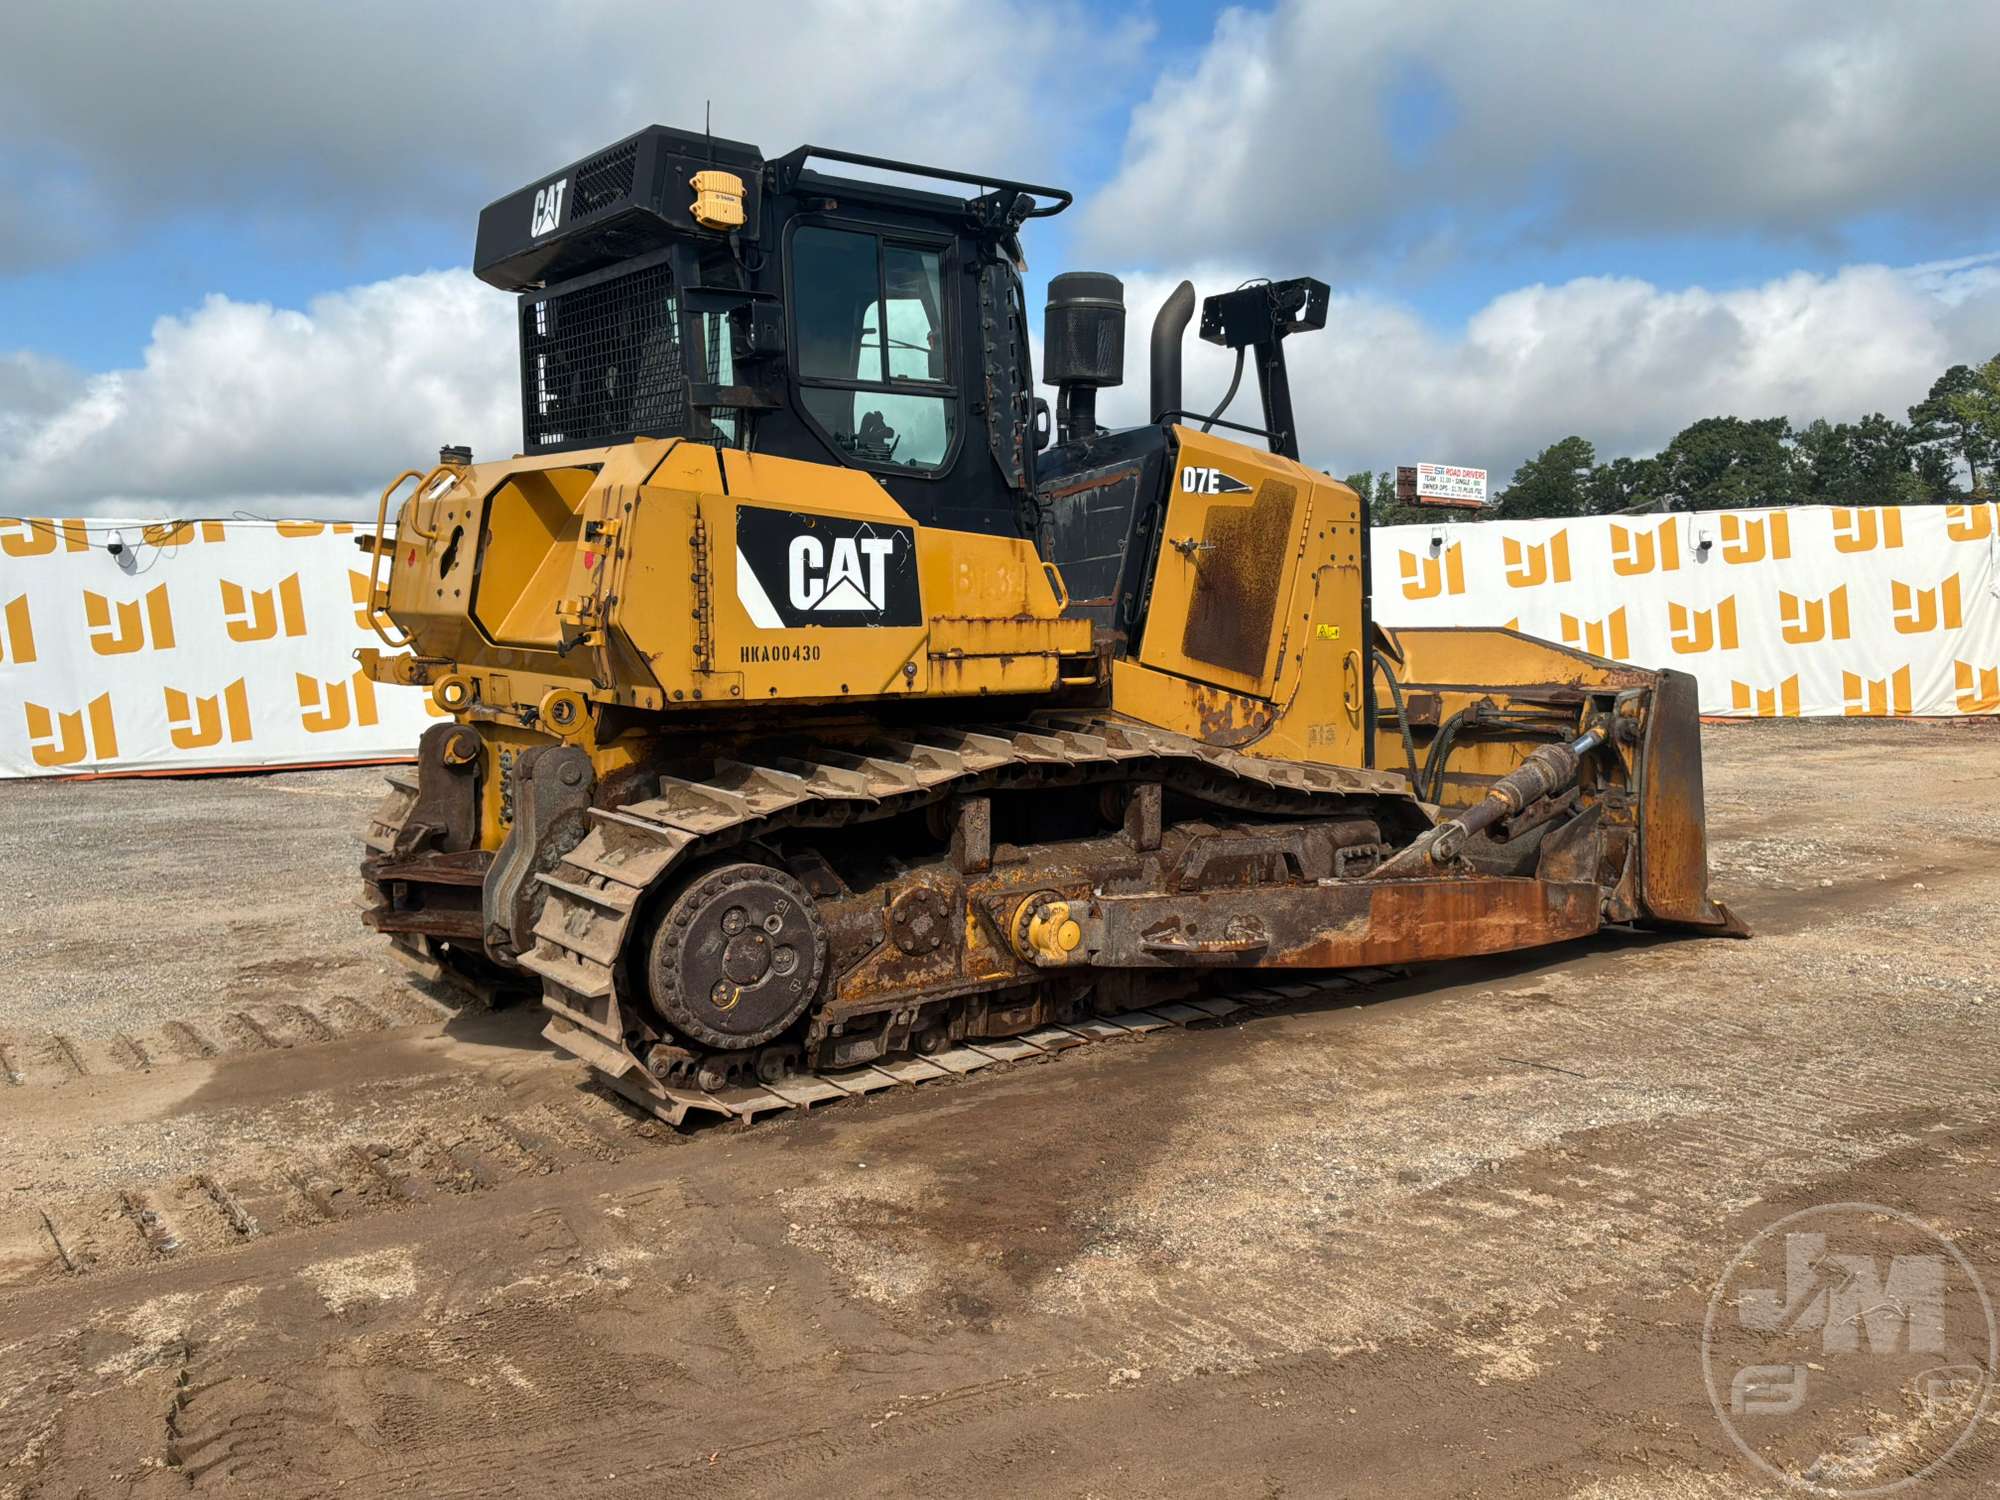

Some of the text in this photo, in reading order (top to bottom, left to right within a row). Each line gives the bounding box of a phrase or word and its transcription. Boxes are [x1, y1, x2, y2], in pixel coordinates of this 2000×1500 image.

[530, 178, 567, 238] CAT
[1182, 466, 1220, 494] D7E
[789, 535, 893, 611] CAT
[740, 645, 821, 663] HKA00430
